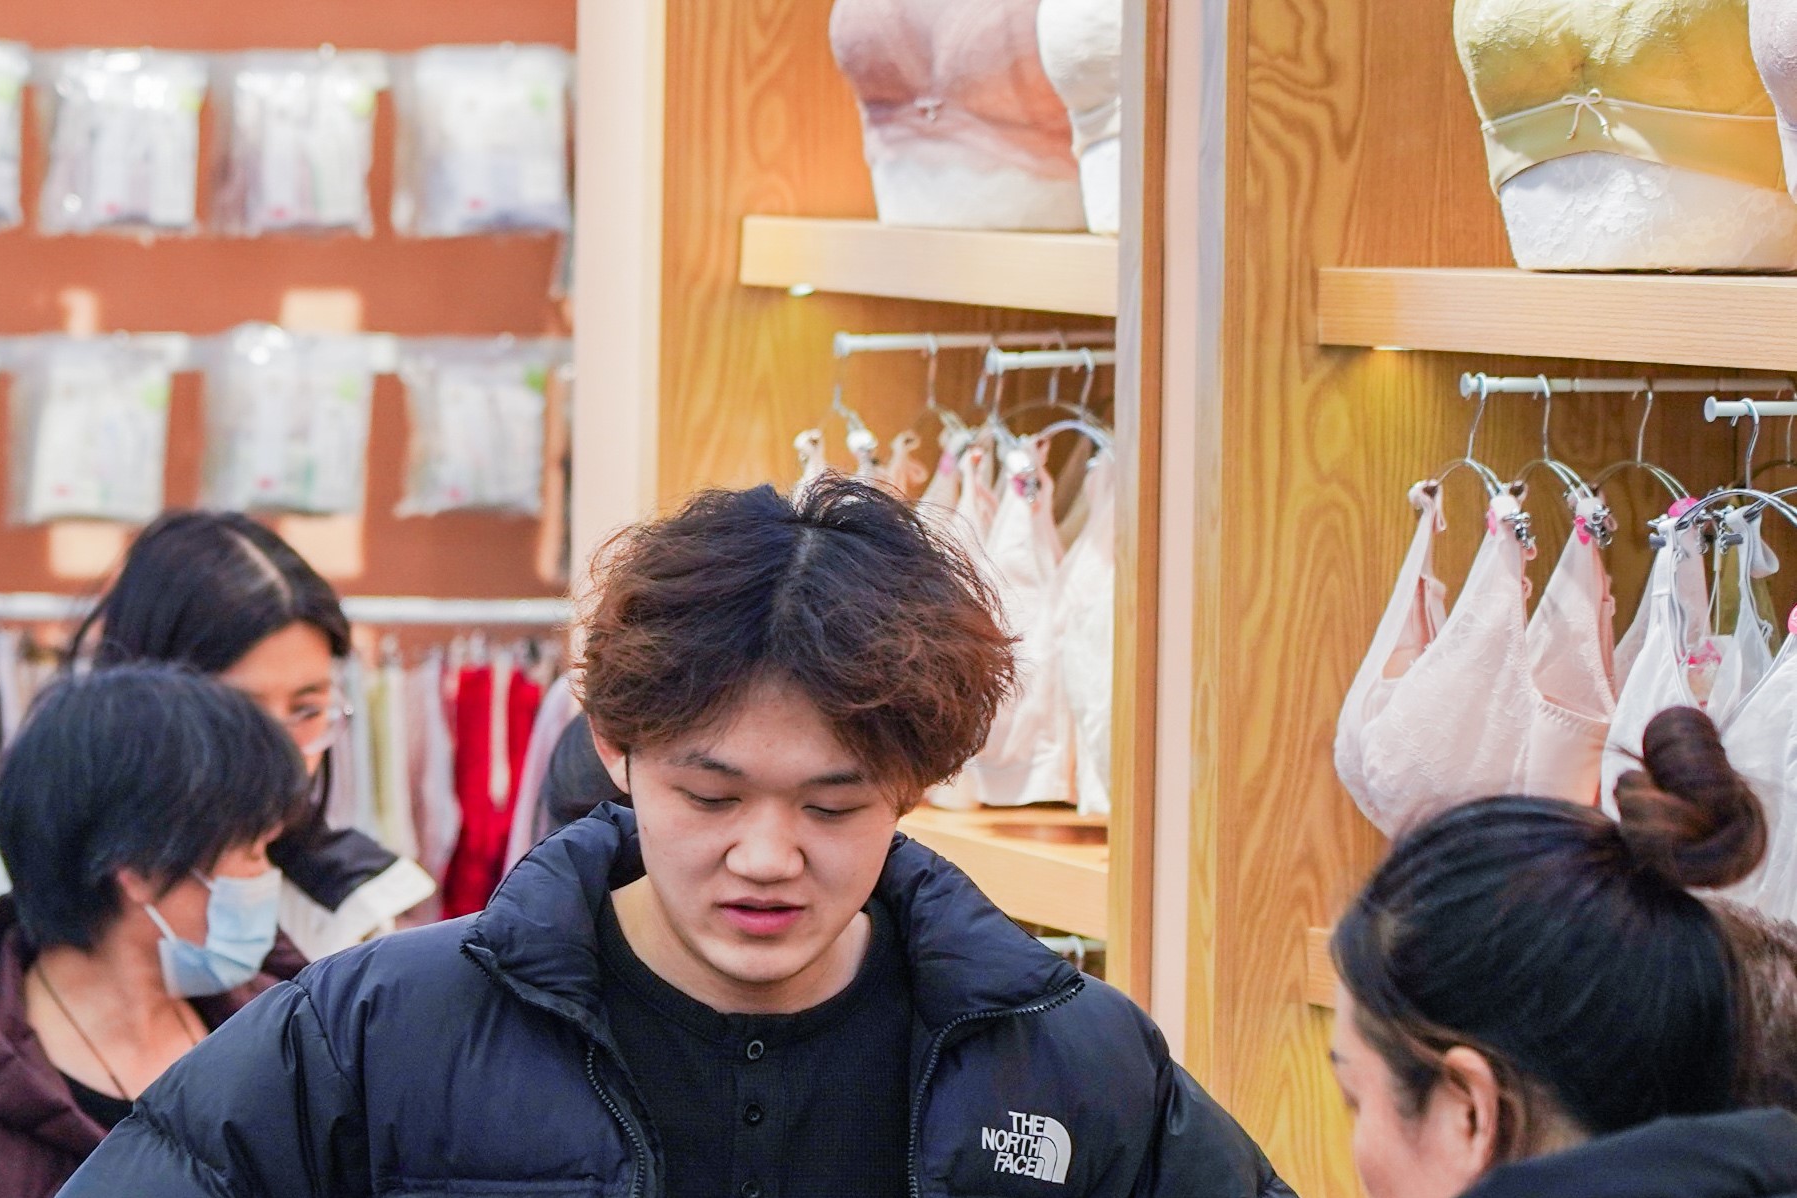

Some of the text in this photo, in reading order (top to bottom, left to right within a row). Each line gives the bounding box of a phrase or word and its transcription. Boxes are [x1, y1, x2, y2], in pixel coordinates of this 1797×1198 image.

[1008, 1110, 1045, 1136] THE
[981, 1126, 1042, 1157] NORTH
[994, 1151, 1037, 1178] FACE
